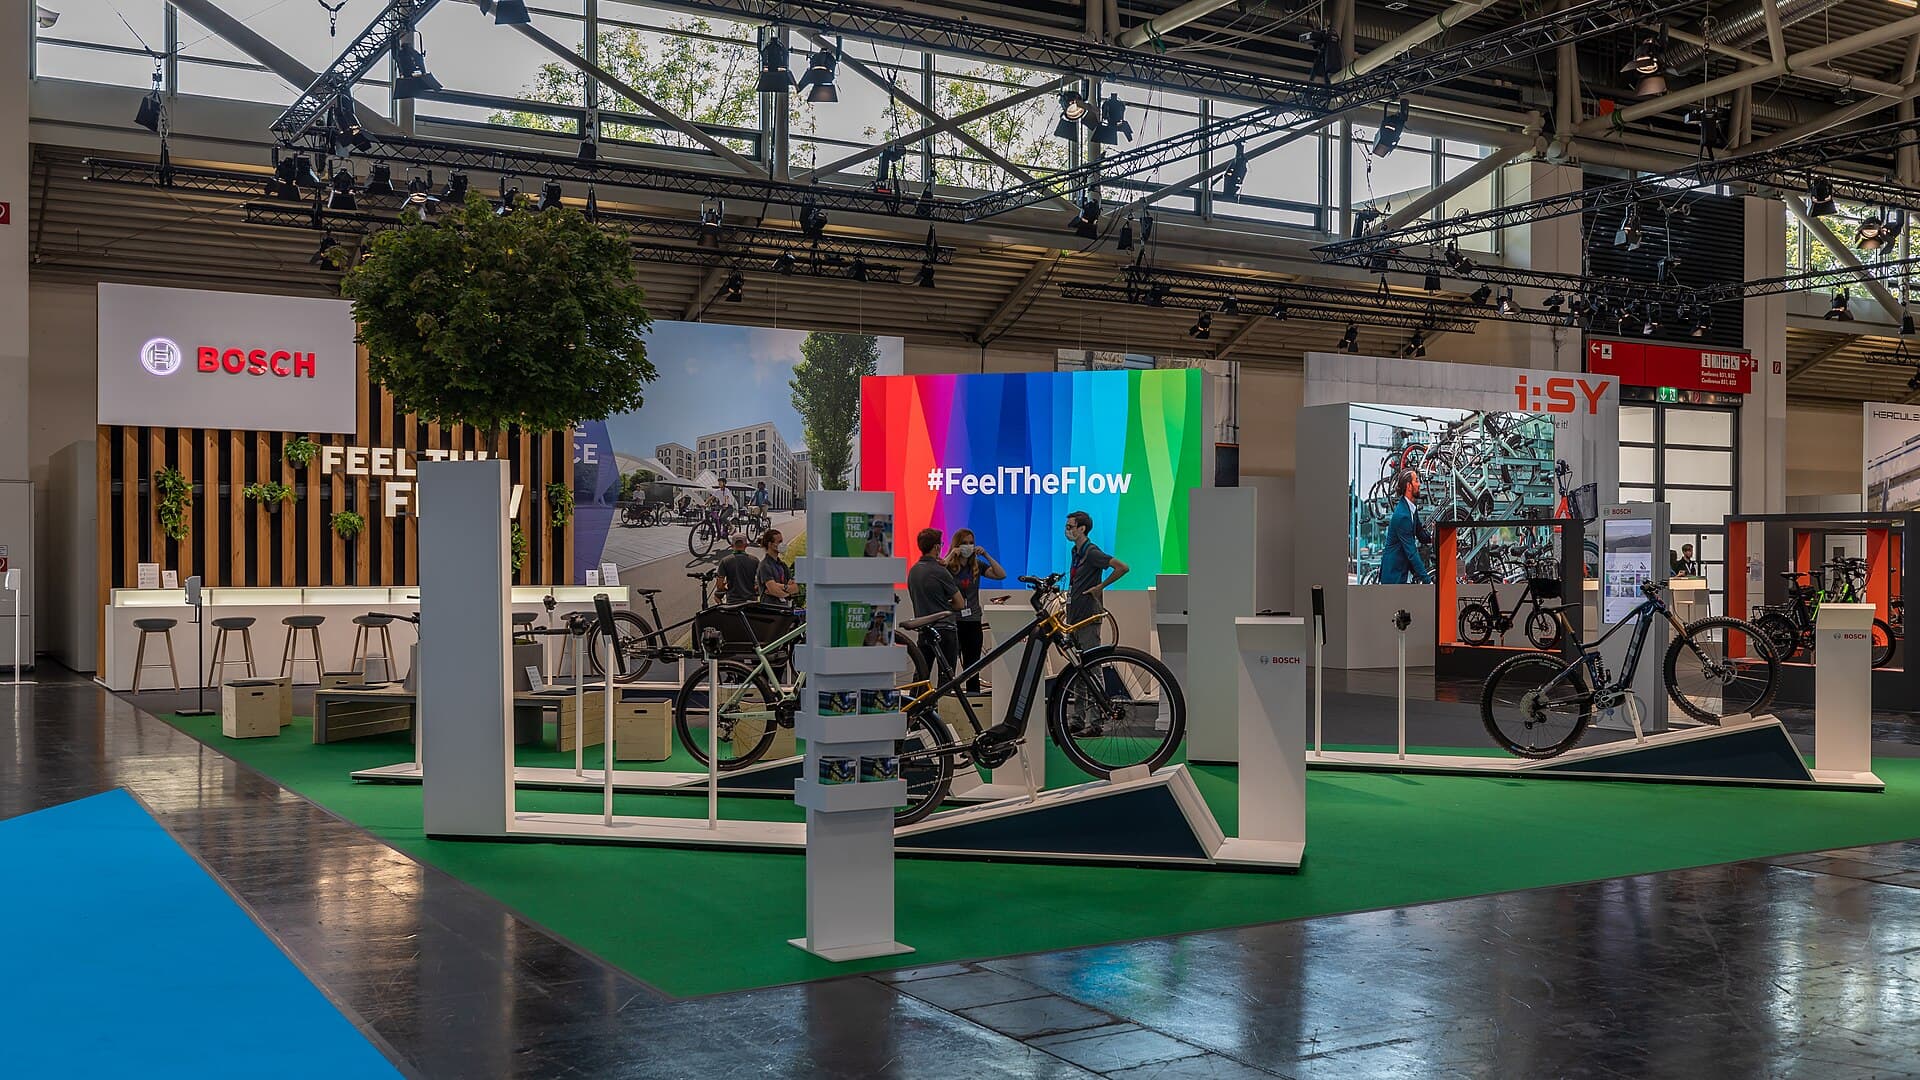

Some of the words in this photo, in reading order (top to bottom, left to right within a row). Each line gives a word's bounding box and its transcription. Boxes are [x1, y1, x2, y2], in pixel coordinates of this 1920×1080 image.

[197, 346, 316, 378] BOSCH
[322, 446, 417, 476] FEEL
[928, 466, 1132, 495] #FeelTheFlow
